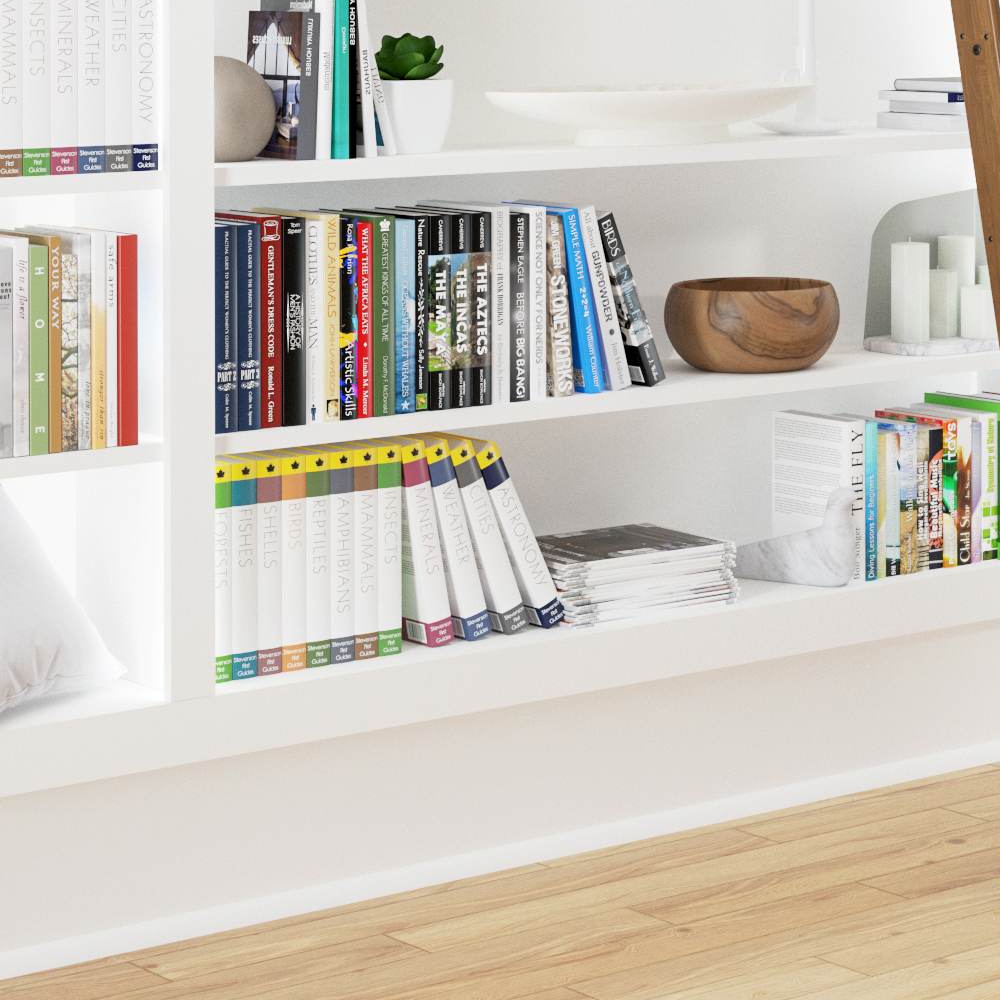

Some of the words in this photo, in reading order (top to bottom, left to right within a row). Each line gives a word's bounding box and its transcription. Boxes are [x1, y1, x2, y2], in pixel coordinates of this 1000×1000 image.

[327, 218, 336, 251] WILD
[361, 228, 369, 256] WHAT
[417, 219, 425, 247] Nature
[517, 217, 525, 253] STEPHEN
[568, 213, 580, 249] SIMPLE
[601, 219, 621, 257] BIRDS
[361, 257, 369, 275] THE
[381, 232, 389, 270] GREATEST
[417, 249, 425, 276] Rescue
[573, 250, 585, 280] MATH
[51, 246, 60, 291] YOUR
[456, 269, 467, 298] THE
[477, 263, 487, 293] THE
[517, 255, 525, 283] EAGLE
[435, 270, 446, 300] THE
[51, 295, 60, 330] WAY
[361, 312, 369, 335] EATS
[456, 302, 467, 353] INCAS
[477, 297, 488, 356] AZTECS
[516, 292, 525, 335] BEFORE
[381, 323, 389, 342] TIME
[401, 318, 409, 358] WITHOUT
[516, 337, 526, 357] BIG
[551, 275, 573, 393] STONEWORKS
[217, 371, 232, 382] PART
[241, 369, 255, 380] PART
[401, 361, 409, 397] WHALES
[345, 386, 356, 416] Skills
[851, 430, 863, 466] FLY
[960, 504, 971, 528] Star
[336, 497, 350, 614] AMPHIBIANS
[960, 532, 971, 563] Child
[868, 554, 876, 579] Diving
